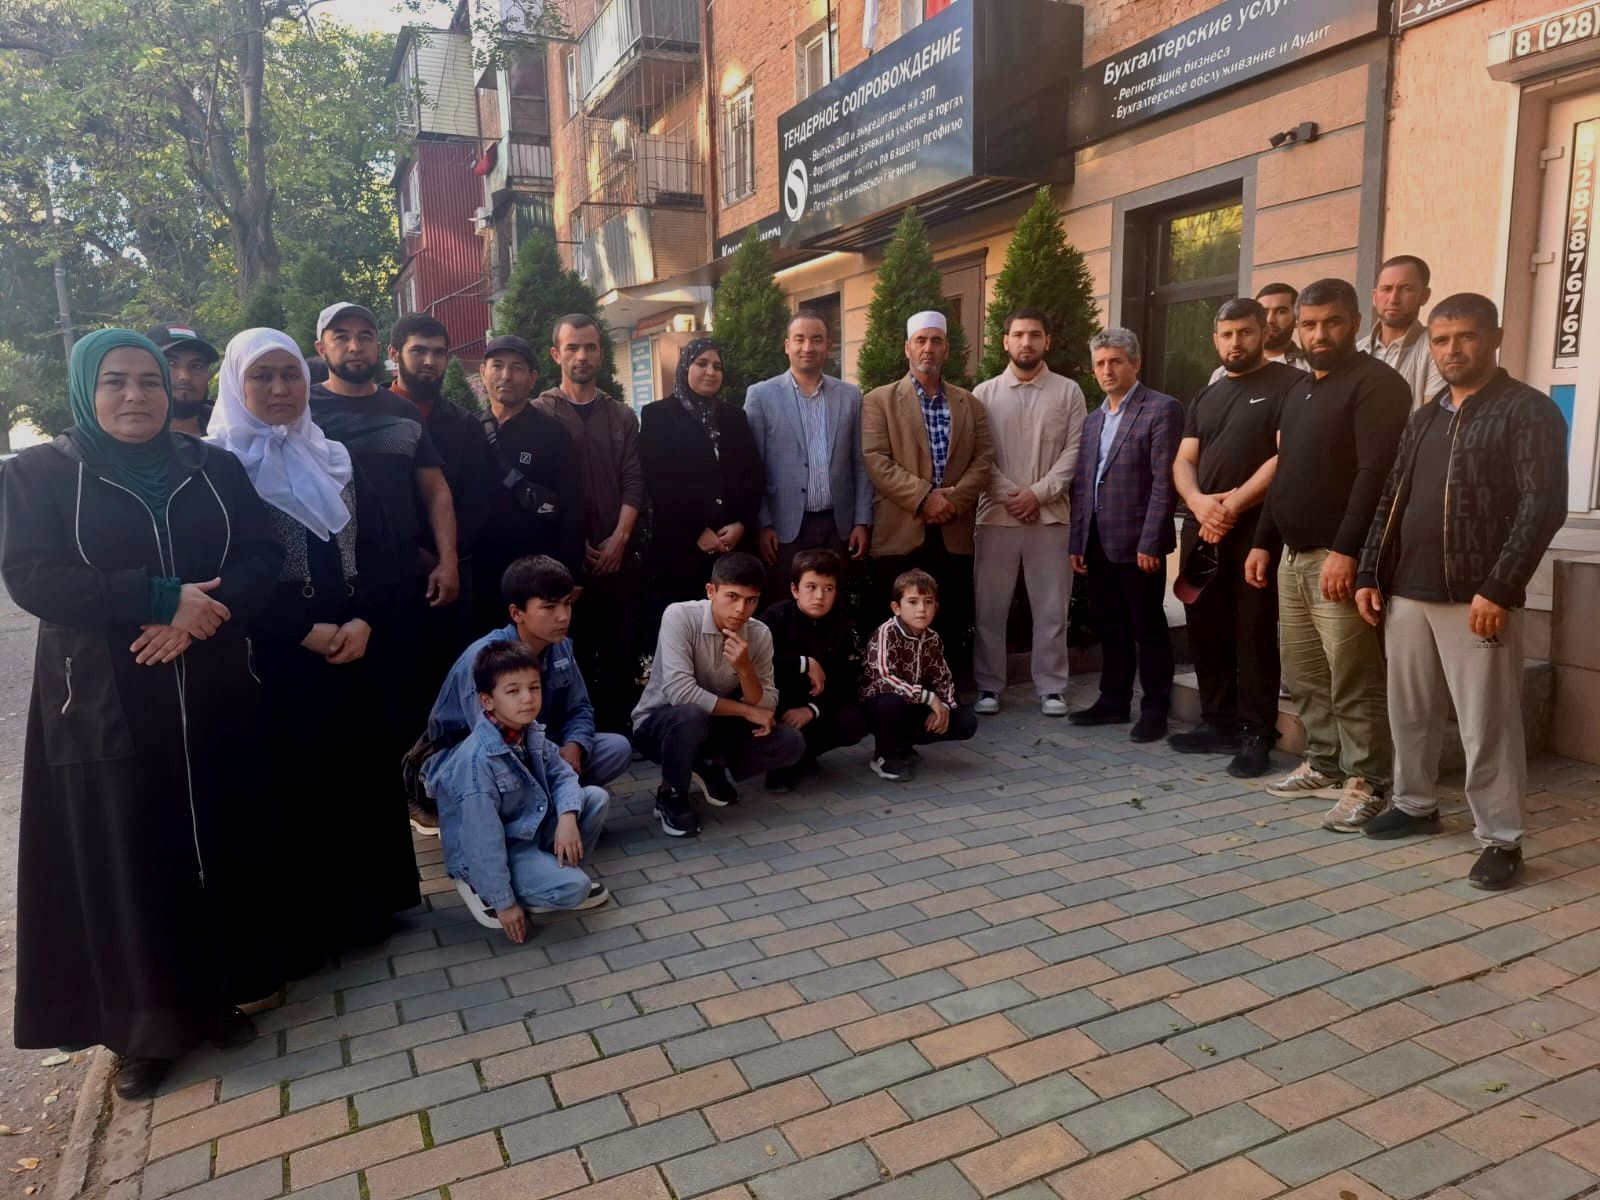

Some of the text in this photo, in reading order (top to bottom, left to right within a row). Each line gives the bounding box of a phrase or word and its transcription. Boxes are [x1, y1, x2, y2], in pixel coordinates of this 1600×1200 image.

[1103, 13, 1232, 86] Бухгалтерские
[1515, 30, 1532, 57] 8
[783, 27, 963, 151] ТЕНДЕРНОЕ СОПРОВОЖДЕНИЕ
[907, 98, 918, 111] на
[919, 84, 936, 105] ЭТП
[1116, 25, 1331, 119] Бухгалтерское обслуживание и Аудит
[1118, 45, 1231, 101] Регистрация бизнеса
[879, 152, 889, 166] по
[922, 117, 963, 145] профилю
[885, 128, 895, 142] на
[928, 109, 934, 121] в
[935, 95, 964, 117] торгах
